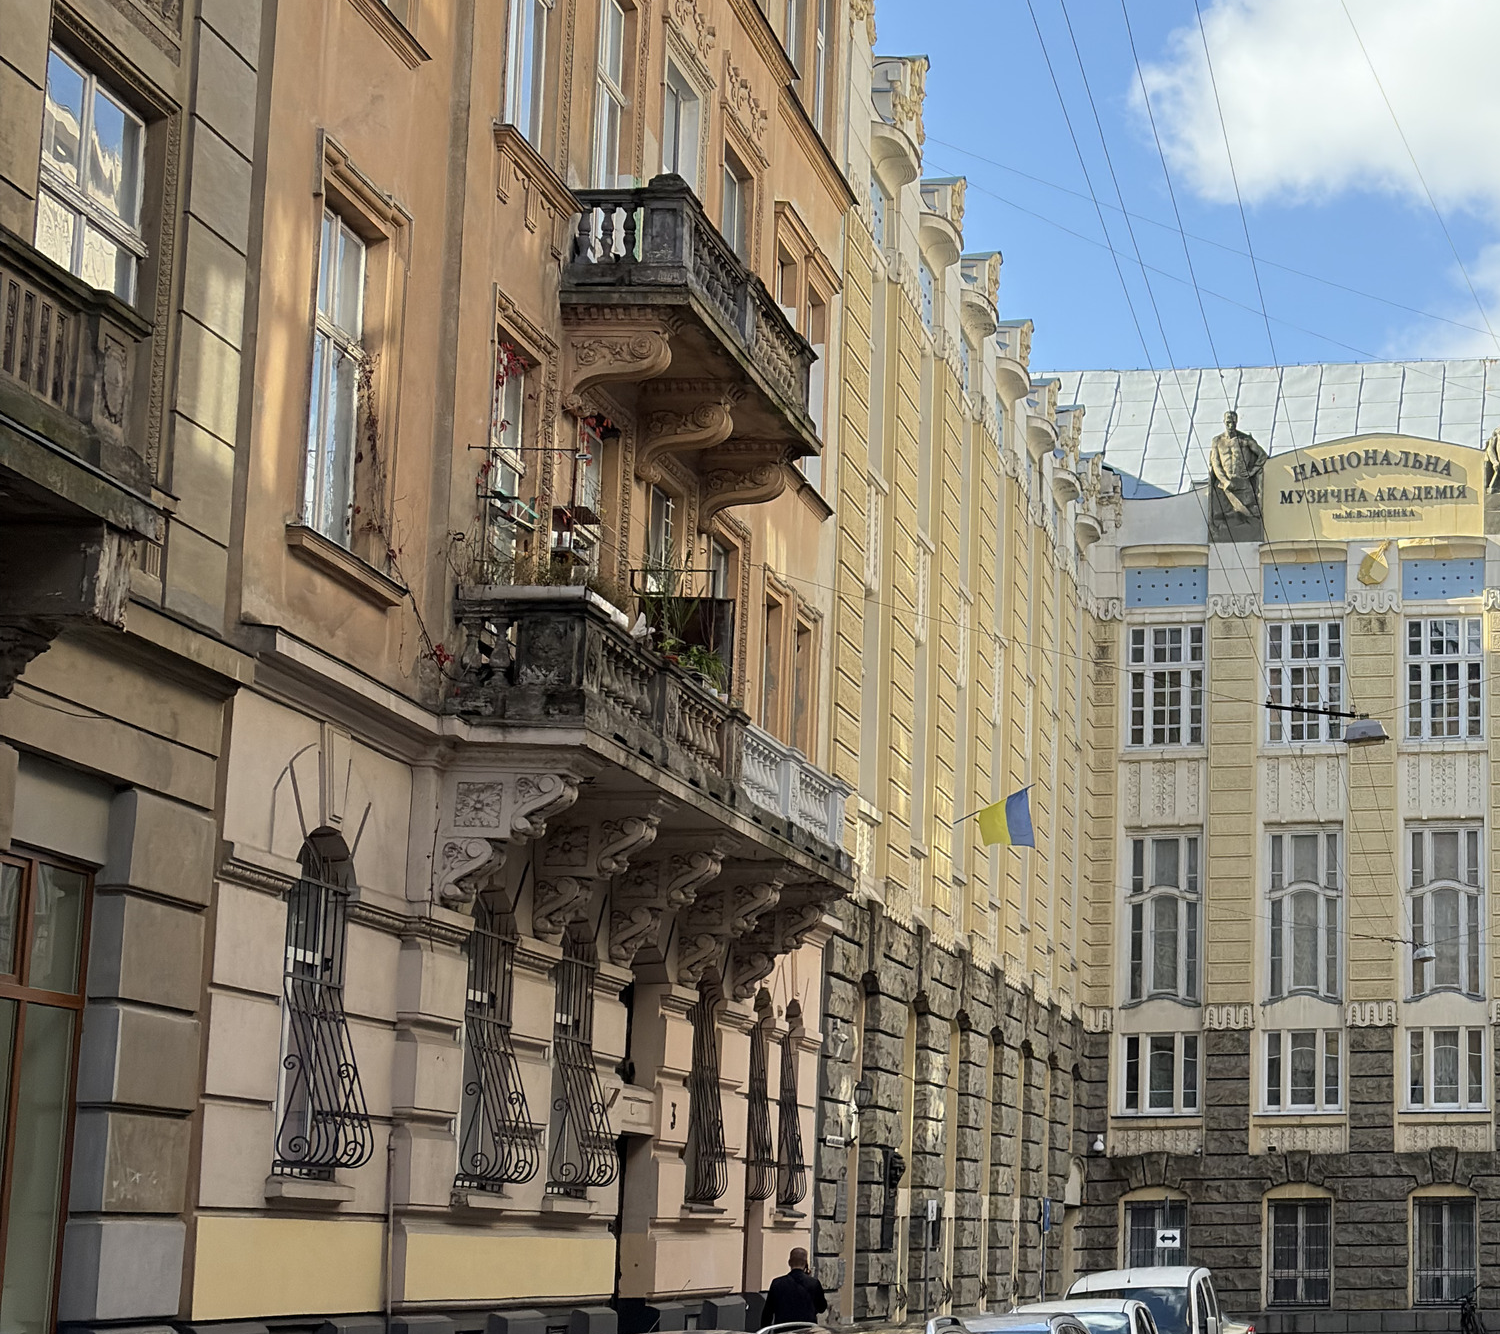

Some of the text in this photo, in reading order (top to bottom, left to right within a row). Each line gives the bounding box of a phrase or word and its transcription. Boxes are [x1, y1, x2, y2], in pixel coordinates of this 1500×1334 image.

[1291, 449, 1452, 483] НАЦІОНАЛЬНА
[1279, 484, 1468, 505] МУЗИЧНА АКАДЕМІЯ
